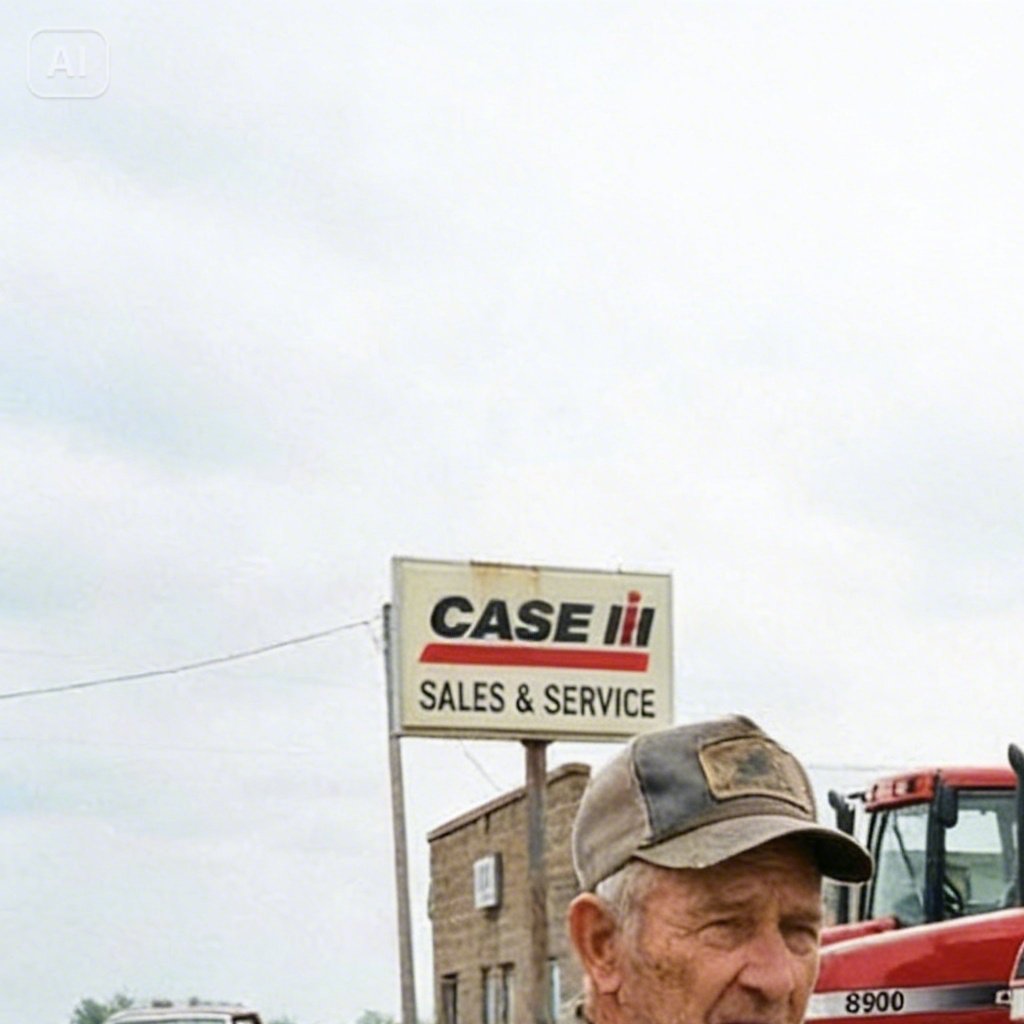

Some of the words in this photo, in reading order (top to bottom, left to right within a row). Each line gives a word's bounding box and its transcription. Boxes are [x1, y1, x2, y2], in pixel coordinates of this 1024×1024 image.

[430, 595, 594, 643] CASE
[419, 680, 505, 713] SALES
[515, 683, 534, 713] &
[543, 684, 656, 718] SERVICE
[845, 990, 905, 1014] 8900
